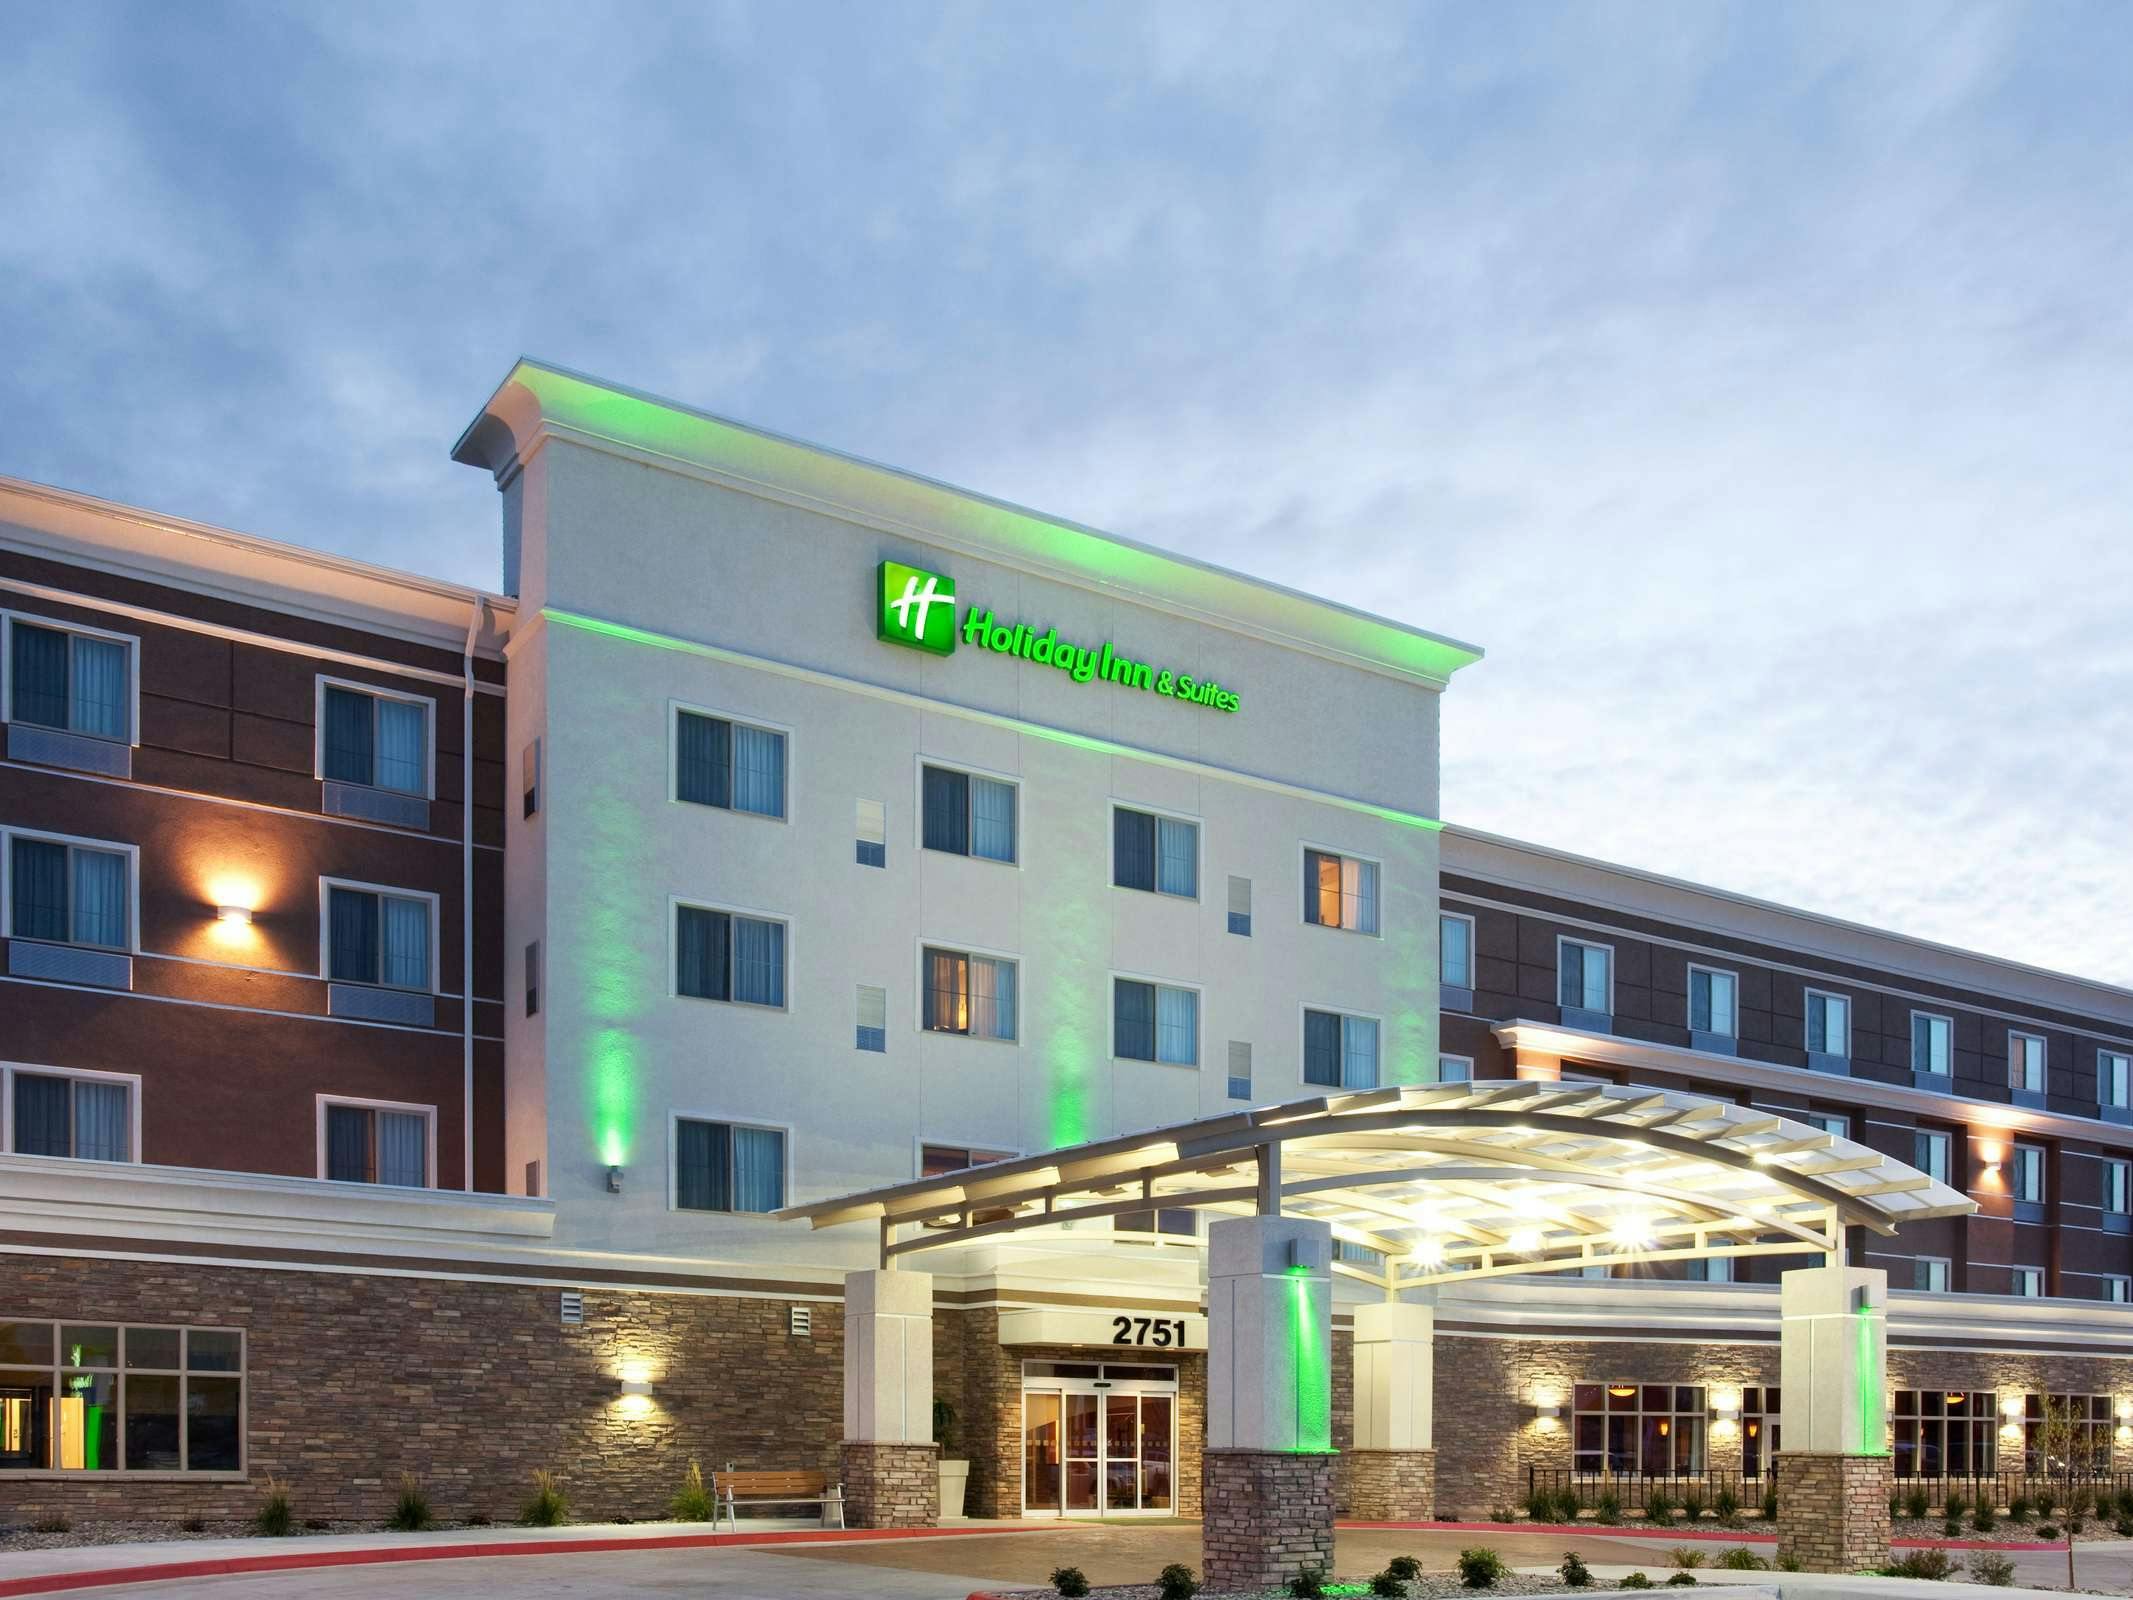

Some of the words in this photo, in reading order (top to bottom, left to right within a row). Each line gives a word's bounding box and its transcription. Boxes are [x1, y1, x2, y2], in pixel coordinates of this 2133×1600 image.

[962, 607, 1097, 682] Holiday
[1099, 641, 1152, 689] Inn
[1157, 669, 1174, 696] &
[1175, 674, 1240, 713] Suites
[1113, 1317, 1185, 1347] 2751
